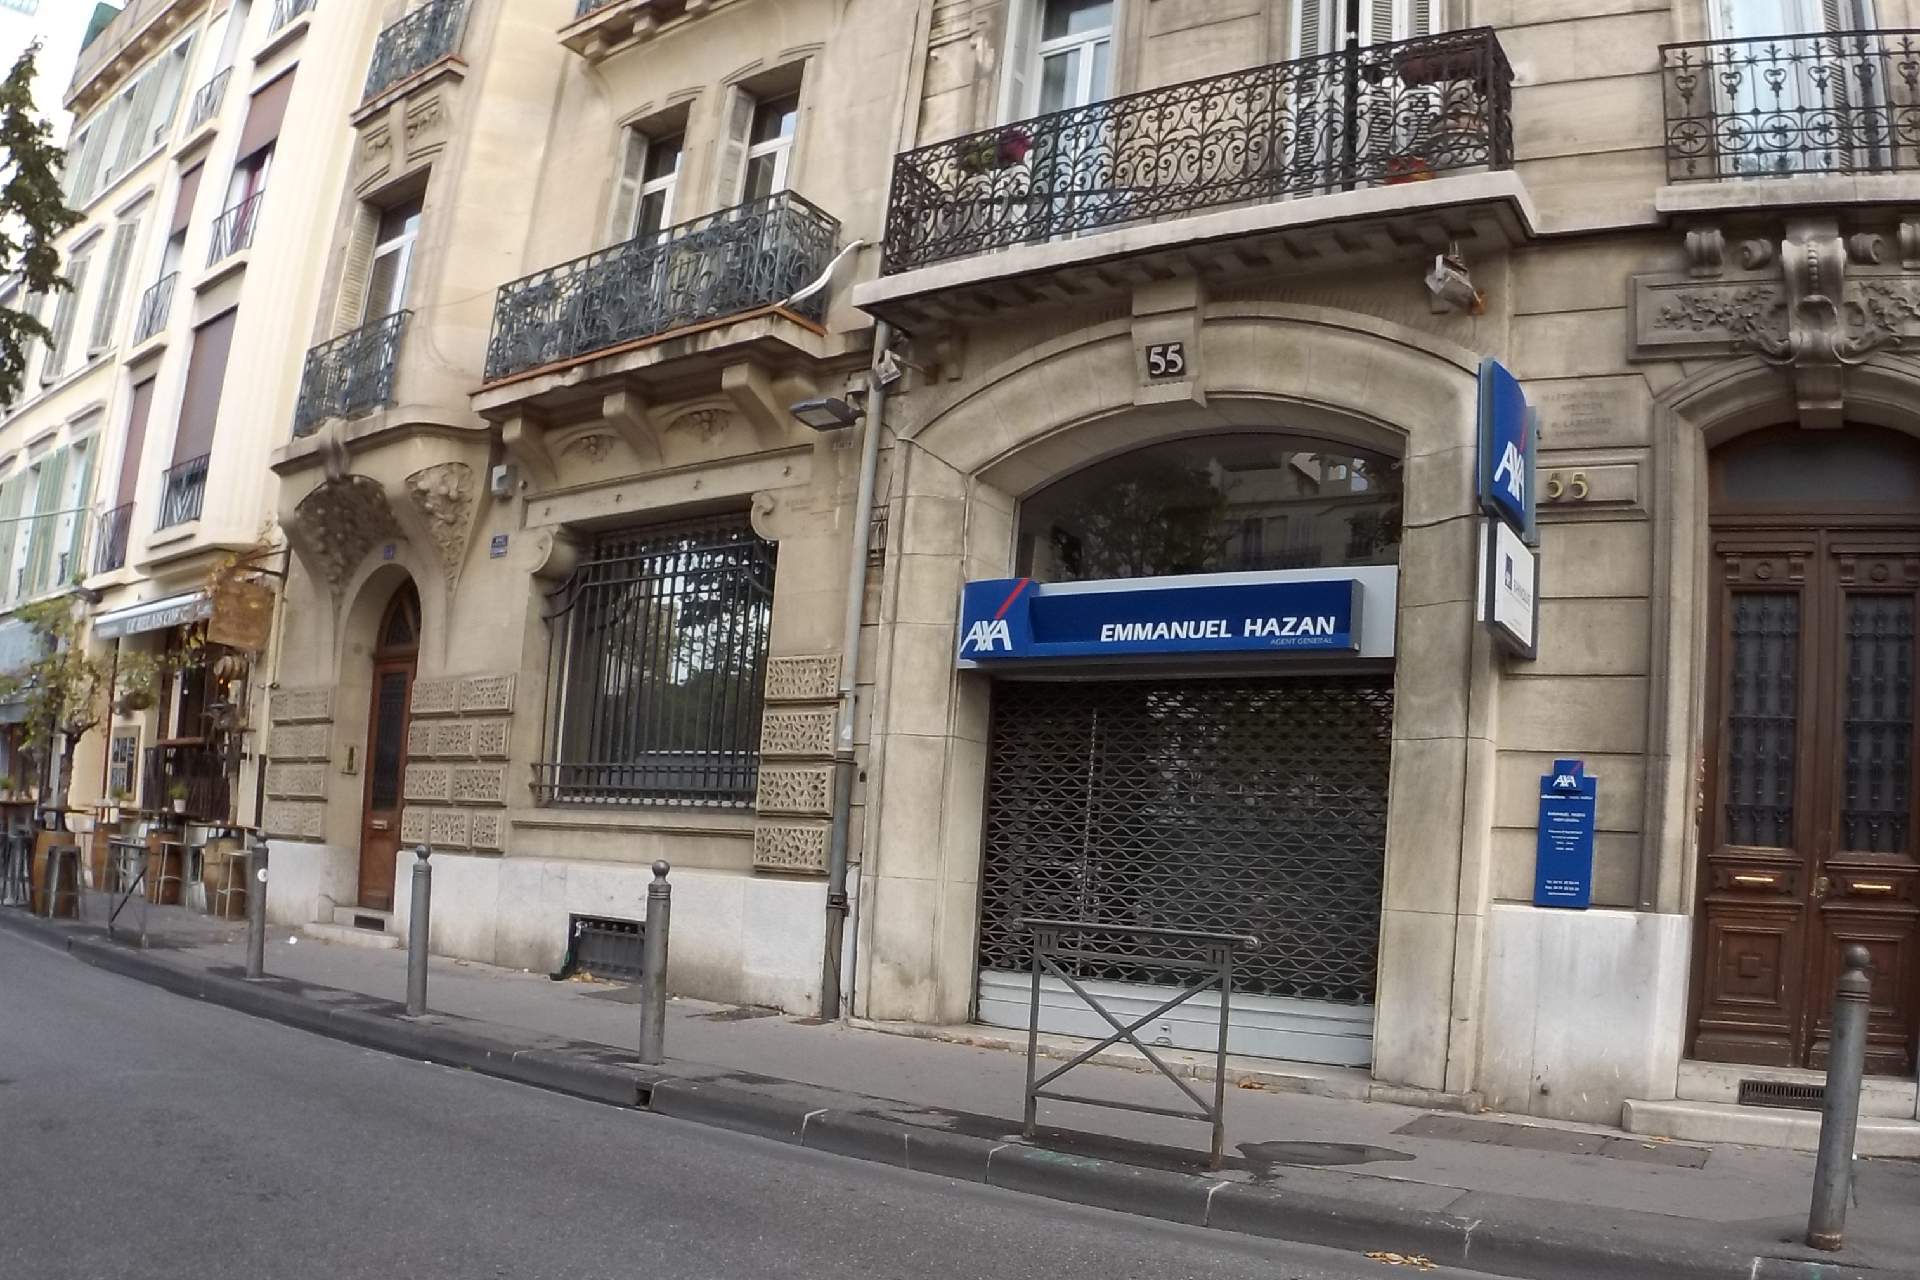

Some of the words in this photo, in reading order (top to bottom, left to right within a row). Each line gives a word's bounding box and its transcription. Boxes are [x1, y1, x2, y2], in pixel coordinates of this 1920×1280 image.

[1149, 344, 1183, 375] 55
[1493, 441, 1526, 511] AXA
[1548, 471, 1590, 499] 55
[960, 619, 1012, 652] AXA
[1100, 618, 1232, 642] EMMANUEL
[1243, 615, 1336, 638] HAZAN
[1269, 637, 1296, 646] AGENT
[1552, 774, 1577, 788] AXA
